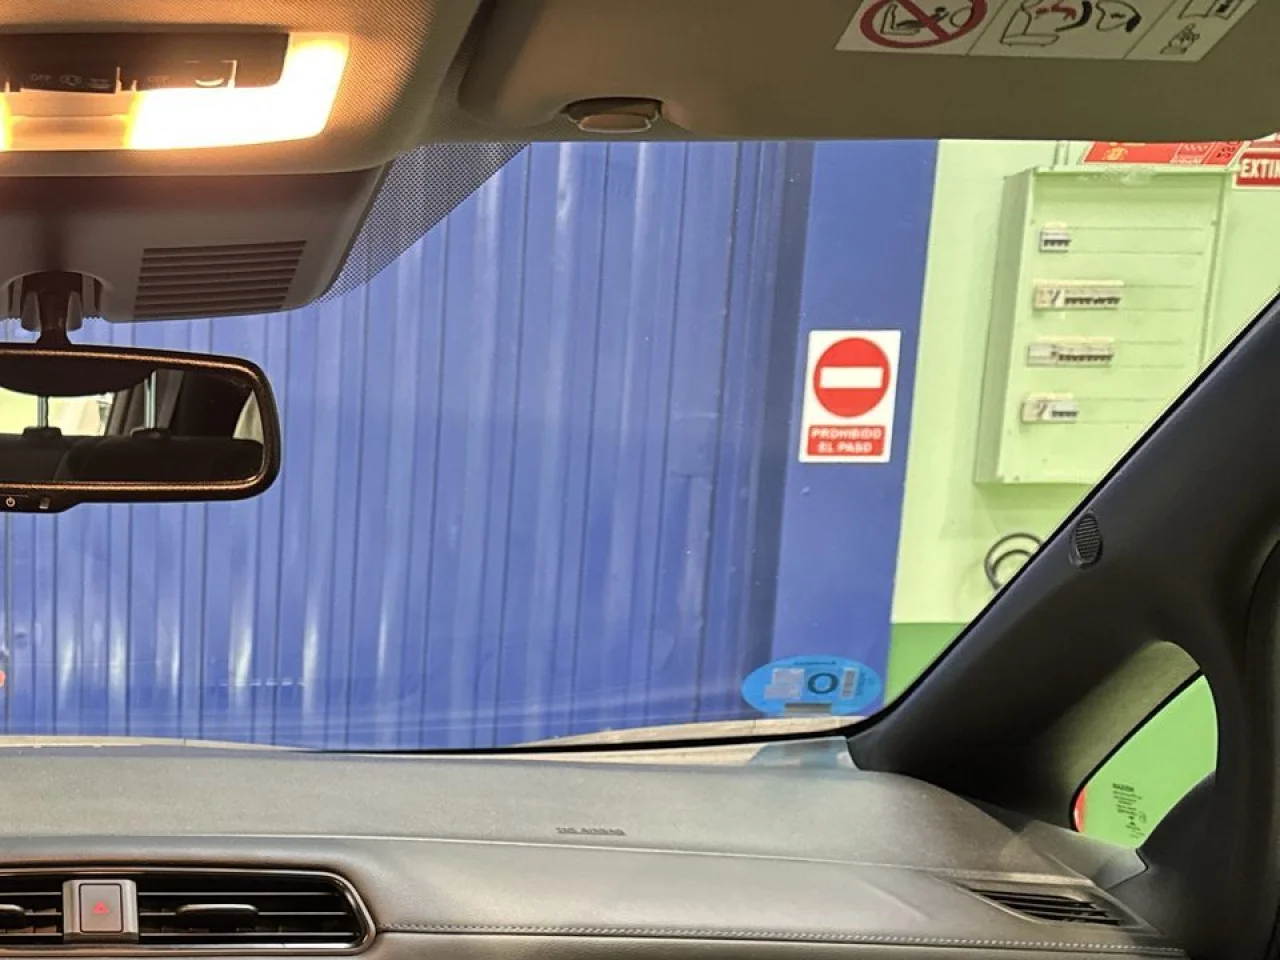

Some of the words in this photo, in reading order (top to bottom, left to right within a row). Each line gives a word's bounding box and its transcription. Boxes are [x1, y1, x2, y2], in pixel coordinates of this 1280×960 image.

[811, 428, 881, 439] PROHIBIDO
[817, 441, 832, 453] EL
[836, 441, 873, 453] PASO
